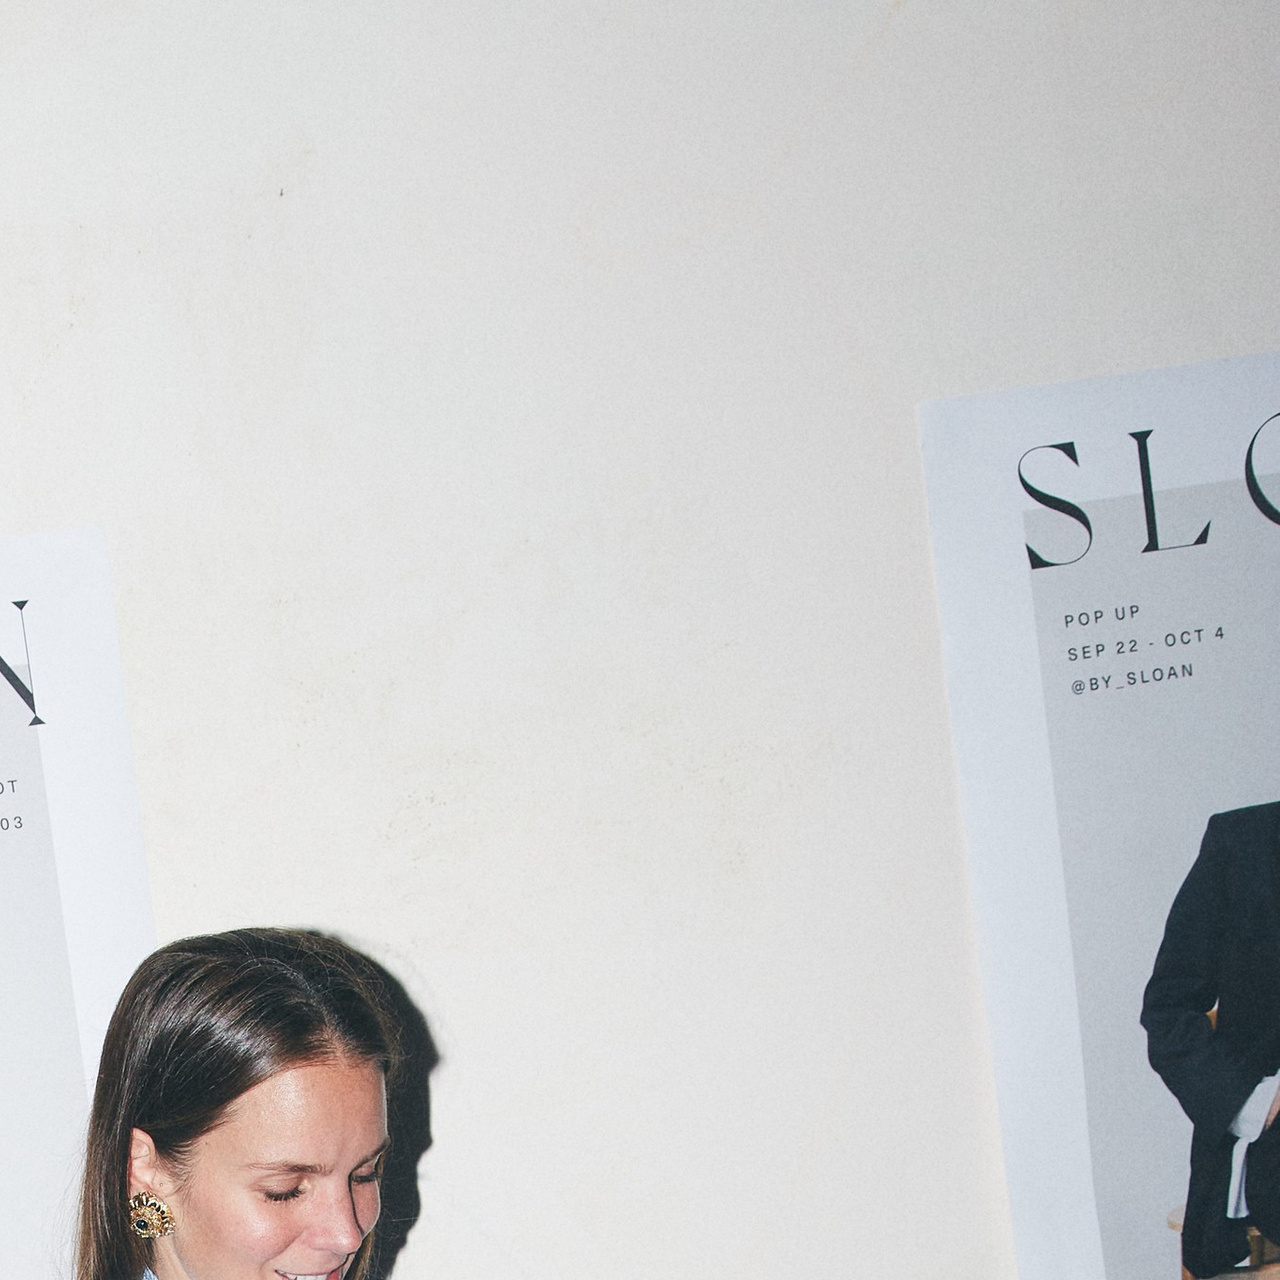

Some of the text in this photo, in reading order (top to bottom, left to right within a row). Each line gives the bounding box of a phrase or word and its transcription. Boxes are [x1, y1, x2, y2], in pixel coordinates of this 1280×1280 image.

[1064, 605, 1141, 628] POP UP
[1067, 643, 1106, 662] SEP
[1116, 639, 1139, 656] 22
[1164, 628, 1205, 647] OCT
[1214, 626, 1226, 640] 4
[1071, 663, 1194, 695] @BY_SLOAN
